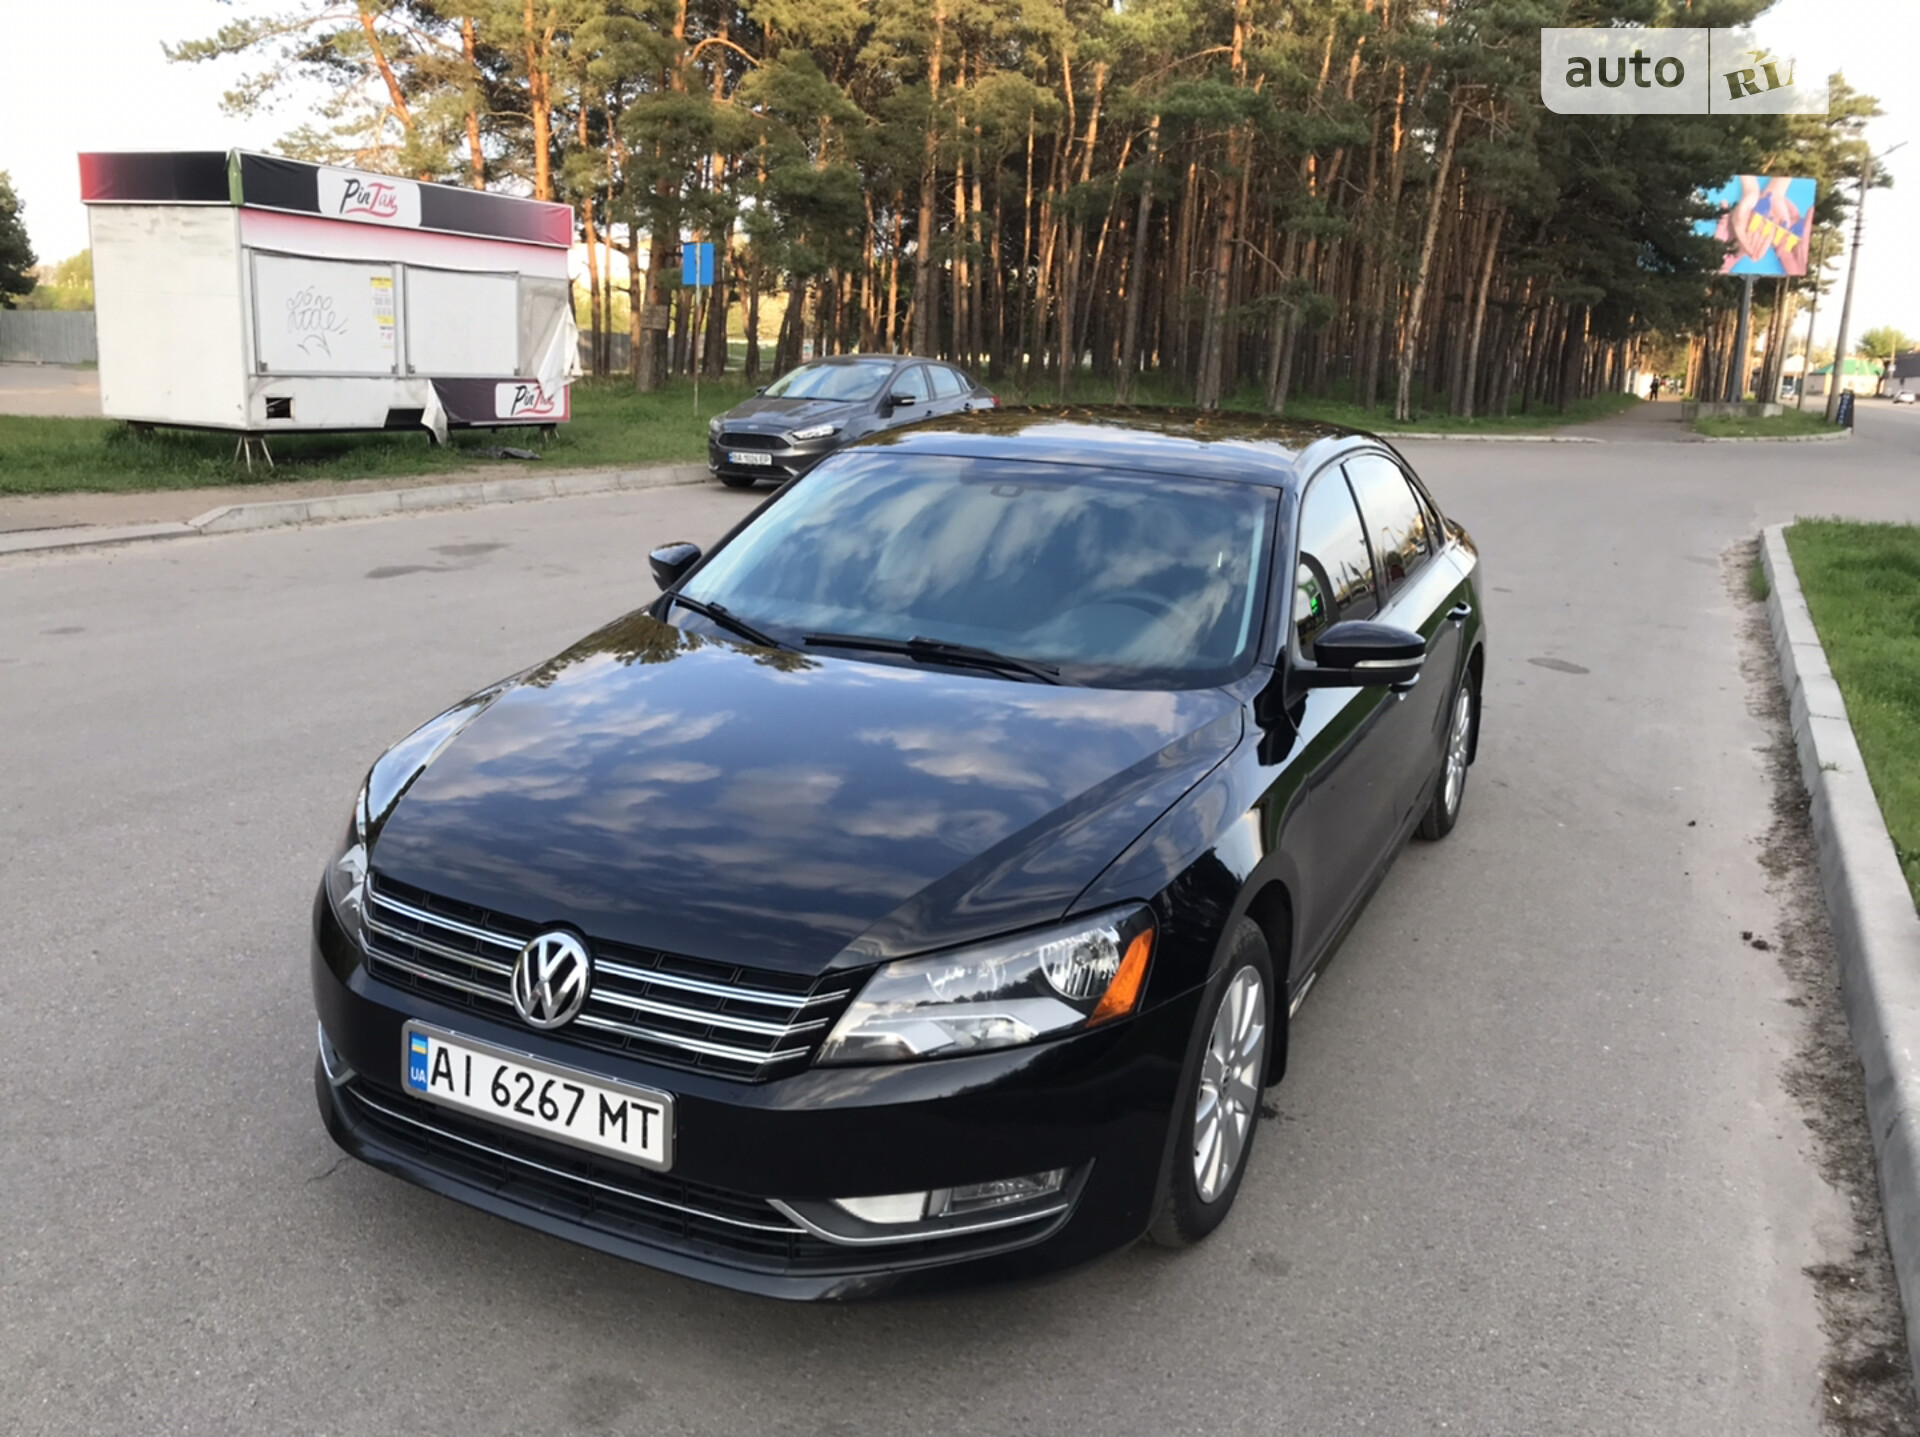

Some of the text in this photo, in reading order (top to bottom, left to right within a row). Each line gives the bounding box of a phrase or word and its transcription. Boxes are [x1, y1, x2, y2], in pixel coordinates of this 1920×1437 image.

[410, 1066, 427, 1084] UA
[430, 1046, 660, 1149] AI 6267 MT
